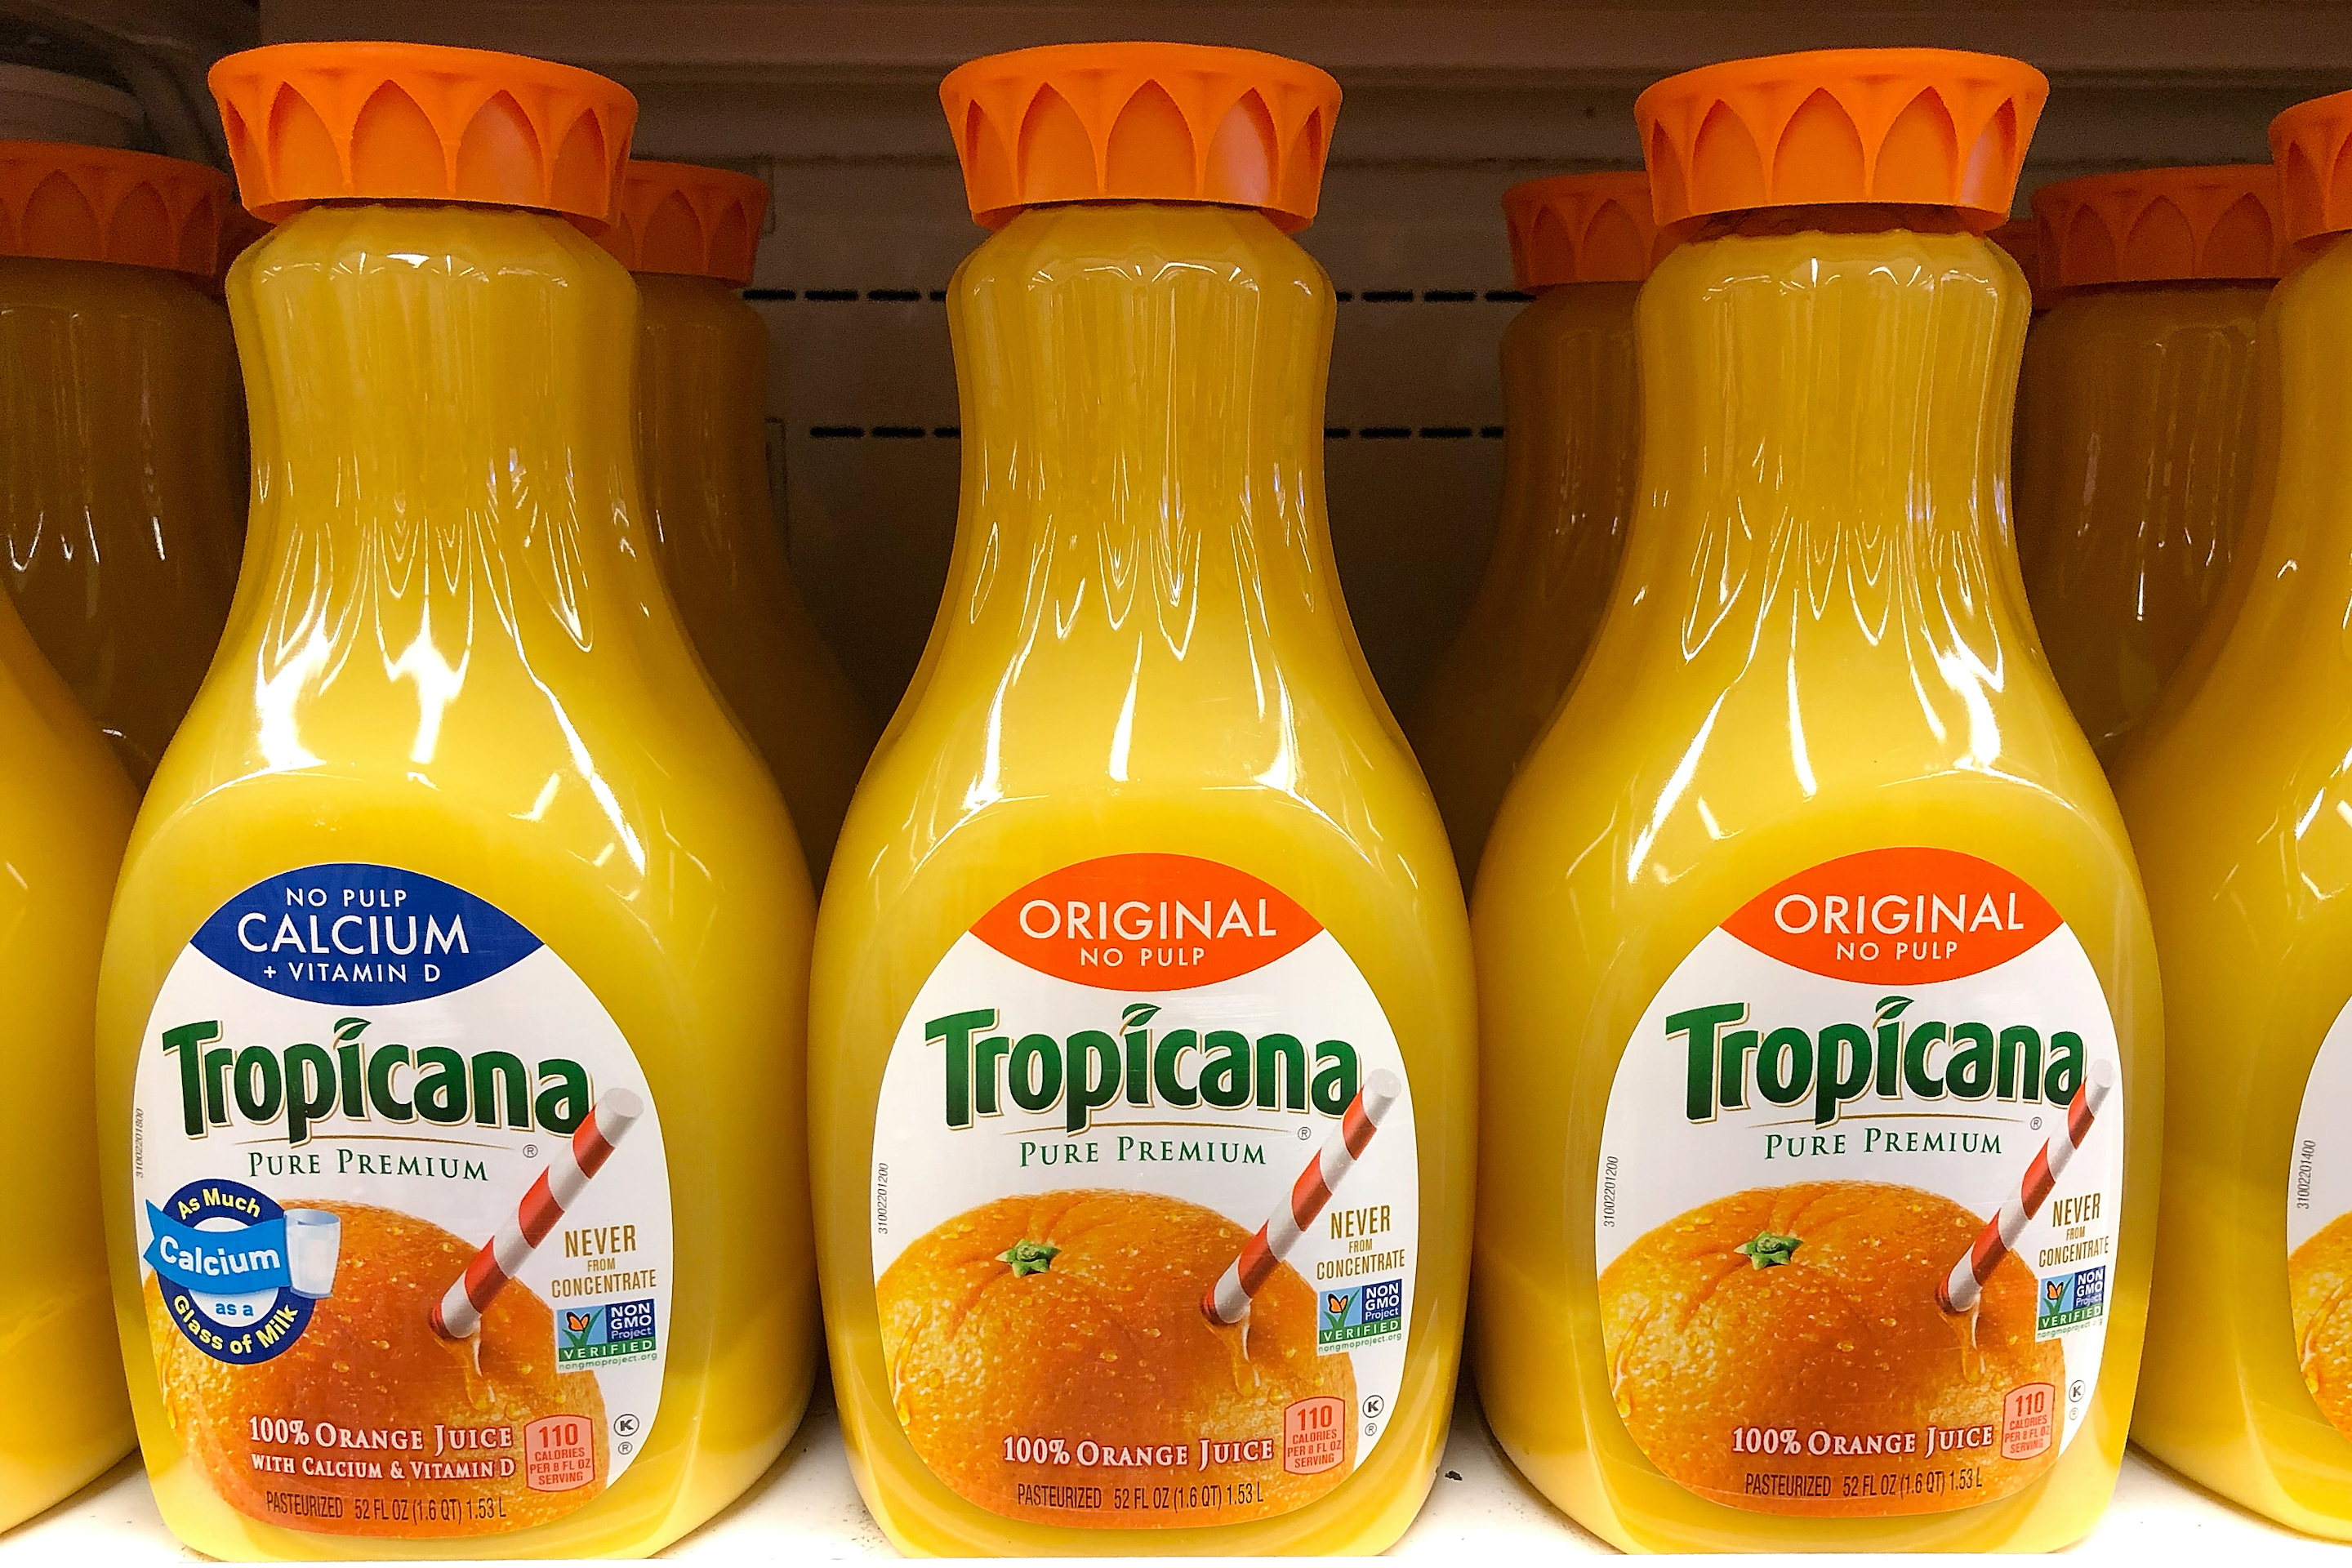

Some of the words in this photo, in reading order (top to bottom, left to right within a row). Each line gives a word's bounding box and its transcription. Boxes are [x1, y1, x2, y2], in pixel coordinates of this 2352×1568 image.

[286, 887, 327, 907] NO
[343, 889, 408, 908] PULP
[1018, 898, 1277, 940] ORIGINAL
[1773, 892, 2025, 935] ORIGINAL
[237, 912, 470, 956] CALCIUM
[1080, 947, 1125, 967] NO
[1140, 947, 1206, 967] PULP
[1836, 942, 1880, 961] NO
[1895, 941, 1958, 960] PULP
[287, 962, 407, 983] VITAMIN
[424, 964, 441, 982] D
[924, 1003, 1360, 1135] Tropicana
[1665, 995, 2087, 1129] Tropicana
[163, 1017, 594, 1147] Tropicana
[1018, 1141, 1099, 1167] PURE
[1116, 1135, 1267, 1165] PREMIUM
[1765, 1132, 1846, 1160] PURE
[1864, 1126, 2002, 1155] PREMIUM
[247, 1151, 321, 1178] PURE
[337, 1148, 489, 1181] PREMIUM
[2296, 1139, 2316, 1209] 31002201400
[177, 1196, 201, 1220] As
[202, 1187, 261, 1218] Much
[877, 1162, 889, 1234] 31002201200
[1603, 1156, 1618, 1227] 31002201200
[2052, 1192, 2100, 1227] NEVER
[1330, 1205, 1391, 1240] NEVER
[2065, 1226, 2086, 1241] FROM
[564, 1224, 636, 1258] NEVER
[1348, 1238, 1373, 1254] FROM
[2038, 1236, 2109, 1267] CONCENTRATE
[159, 1235, 281, 1276] Calcium
[586, 1257, 616, 1272] FROM
[1316, 1248, 1405, 1280] CONCENTRATE
[551, 1268, 657, 1298] CONCENTRATE
[2078, 1268, 2104, 1285] NON
[1365, 1282, 1399, 1299] NON
[2075, 1292, 2103, 1307] Project
[2076, 1281, 2104, 1298] GMO
[215, 1303, 237, 1316] as
[243, 1303, 254, 1316] a
[610, 1302, 651, 1318] NON
[1365, 1295, 1400, 1311] GMO
[1365, 1307, 1399, 1321] Project
[173, 1294, 224, 1351] Glass
[229, 1334, 252, 1355] of
[255, 1303, 299, 1348] Milk
[610, 1314, 652, 1330] GMO
[2042, 1305, 2102, 1328] VERIFIED
[610, 1326, 652, 1340] Project
[1318, 1332, 1402, 1352] nongmoproject.org
[1323, 1320, 1399, 1342] VERIFIED
[558, 1352, 657, 1370] nongmoproject.org
[564, 1339, 653, 1360] VERIFIED
[2016, 1391, 2045, 1417] 110
[1297, 1405, 1333, 1431] 110
[2009, 1414, 2047, 1431] CALORIES
[248, 1415, 310, 1446] 100%
[315, 1422, 423, 1450] ORANGE
[434, 1424, 513, 1456] JUICE
[539, 1423, 578, 1449] 110
[1292, 1428, 1338, 1445] CALORIES
[1732, 1427, 1802, 1454] 100%
[1807, 1430, 1916, 1455] ORANGE
[1925, 1425, 1993, 1459] JUICE
[2004, 1431, 2020, 1443] PER
[2022, 1430, 2028, 1440] 8
[2029, 1428, 2038, 1438] FL
[2040, 1425, 2051, 1437] OZ
[2010, 1438, 2044, 1454] SERVING
[534, 1446, 586, 1462] CALORIES
[1004, 1435, 1071, 1465] 100%
[1076, 1441, 1188, 1467] ORANGE
[1198, 1438, 1274, 1471] JUICE
[1287, 1445, 1306, 1458] PER
[1308, 1445, 1314, 1454] 8
[1316, 1443, 1327, 1453] FL
[1330, 1440, 1342, 1451] OZ
[1294, 1453, 1334, 1468] SERVING
[250, 1452, 295, 1474] WITH
[301, 1456, 383, 1479] CALCIUM
[390, 1460, 405, 1479] &
[410, 1459, 494, 1480] VITAMIN
[499, 1458, 515, 1477] D
[529, 1461, 550, 1475] PER
[553, 1462, 559, 1472] 8
[563, 1460, 575, 1472] FL
[577, 1458, 591, 1469] OZ
[538, 1471, 584, 1486] SERVING
[1745, 1472, 1831, 1498] PASTEURIZED
[1842, 1475, 1857, 1497] 52
[1862, 1474, 1877, 1496] FL
[1881, 1473, 1897, 1495] OZ
[1900, 1472, 1922, 1500] (1.6
[1927, 1470, 1945, 1496] QT)
[1950, 1468, 1973, 1491] 1.53
[1976, 1467, 1983, 1488] L
[265, 1490, 344, 1518] PASTEURIZED
[354, 1499, 370, 1520] 52
[374, 1499, 390, 1520] FL
[392, 1498, 409, 1521] OZ
[412, 1498, 437, 1526] (1.6
[441, 1498, 462, 1526] QT)
[466, 1496, 494, 1520] 1.53
[499, 1496, 507, 1517] L
[1018, 1482, 1102, 1509] PASTEURIZED
[1114, 1487, 1130, 1509] 52
[1134, 1487, 1148, 1509] FL
[1153, 1487, 1169, 1509] OZ
[1174, 1486, 1197, 1513] (1.6
[1201, 1484, 1222, 1511] QT)
[1227, 1482, 1253, 1505] 1.53
[1257, 1481, 1264, 1503] L
